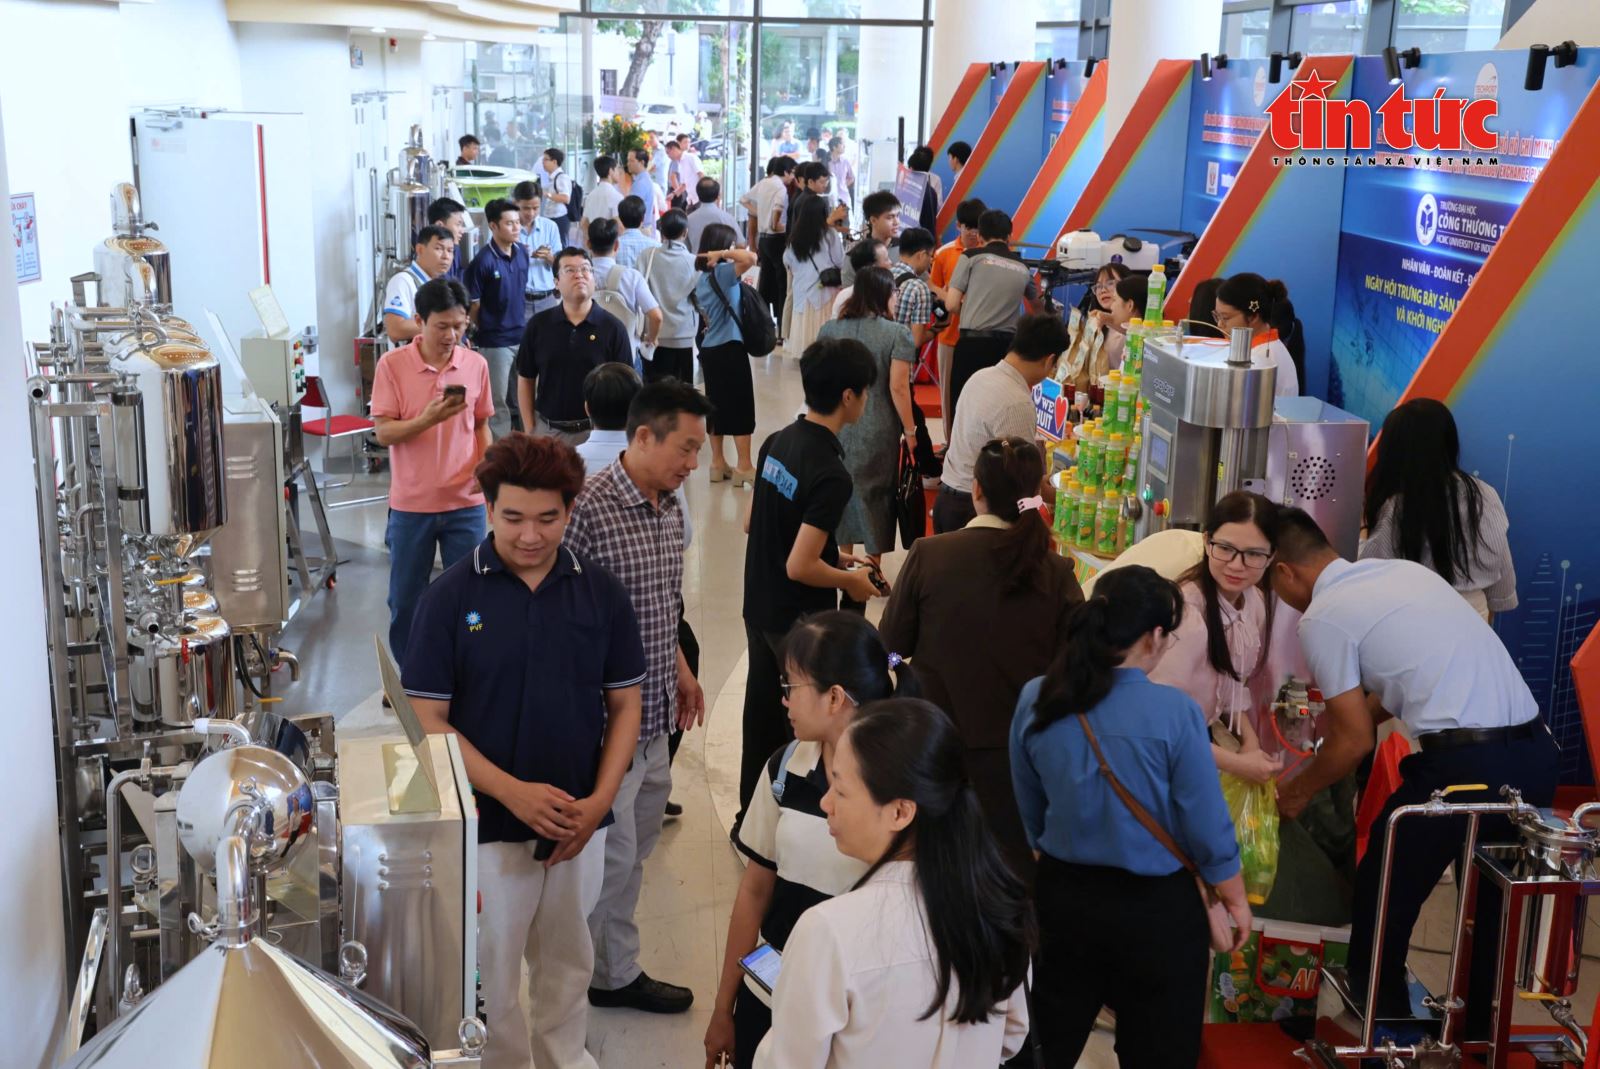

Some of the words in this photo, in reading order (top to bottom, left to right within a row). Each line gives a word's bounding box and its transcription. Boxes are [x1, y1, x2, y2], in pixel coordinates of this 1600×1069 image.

[1438, 212, 1460, 231] CÔNG
[1462, 218, 1498, 238] THƯƠNG
[1448, 236, 1474, 250] UNIVERSITY
[1474, 242, 1480, 251] OF
[1402, 258, 1418, 272] NHÂN
[1419, 261, 1430, 276] VĂN
[1434, 266, 1451, 281] ĐOÀN
[1452, 268, 1464, 285] KẾT
[1365, 274, 1384, 292] NGÀY
[1384, 279, 1397, 299] HỘI
[1398, 284, 1422, 304] TRƯNG
[1423, 289, 1438, 308] BÀY
[1439, 292, 1455, 313] SẢN
[1397, 305, 1405, 322] VÀ
[1407, 308, 1425, 329] KHỞI
[1041, 397, 1055, 414] WE
[470, 623, 483, 633] PVF
